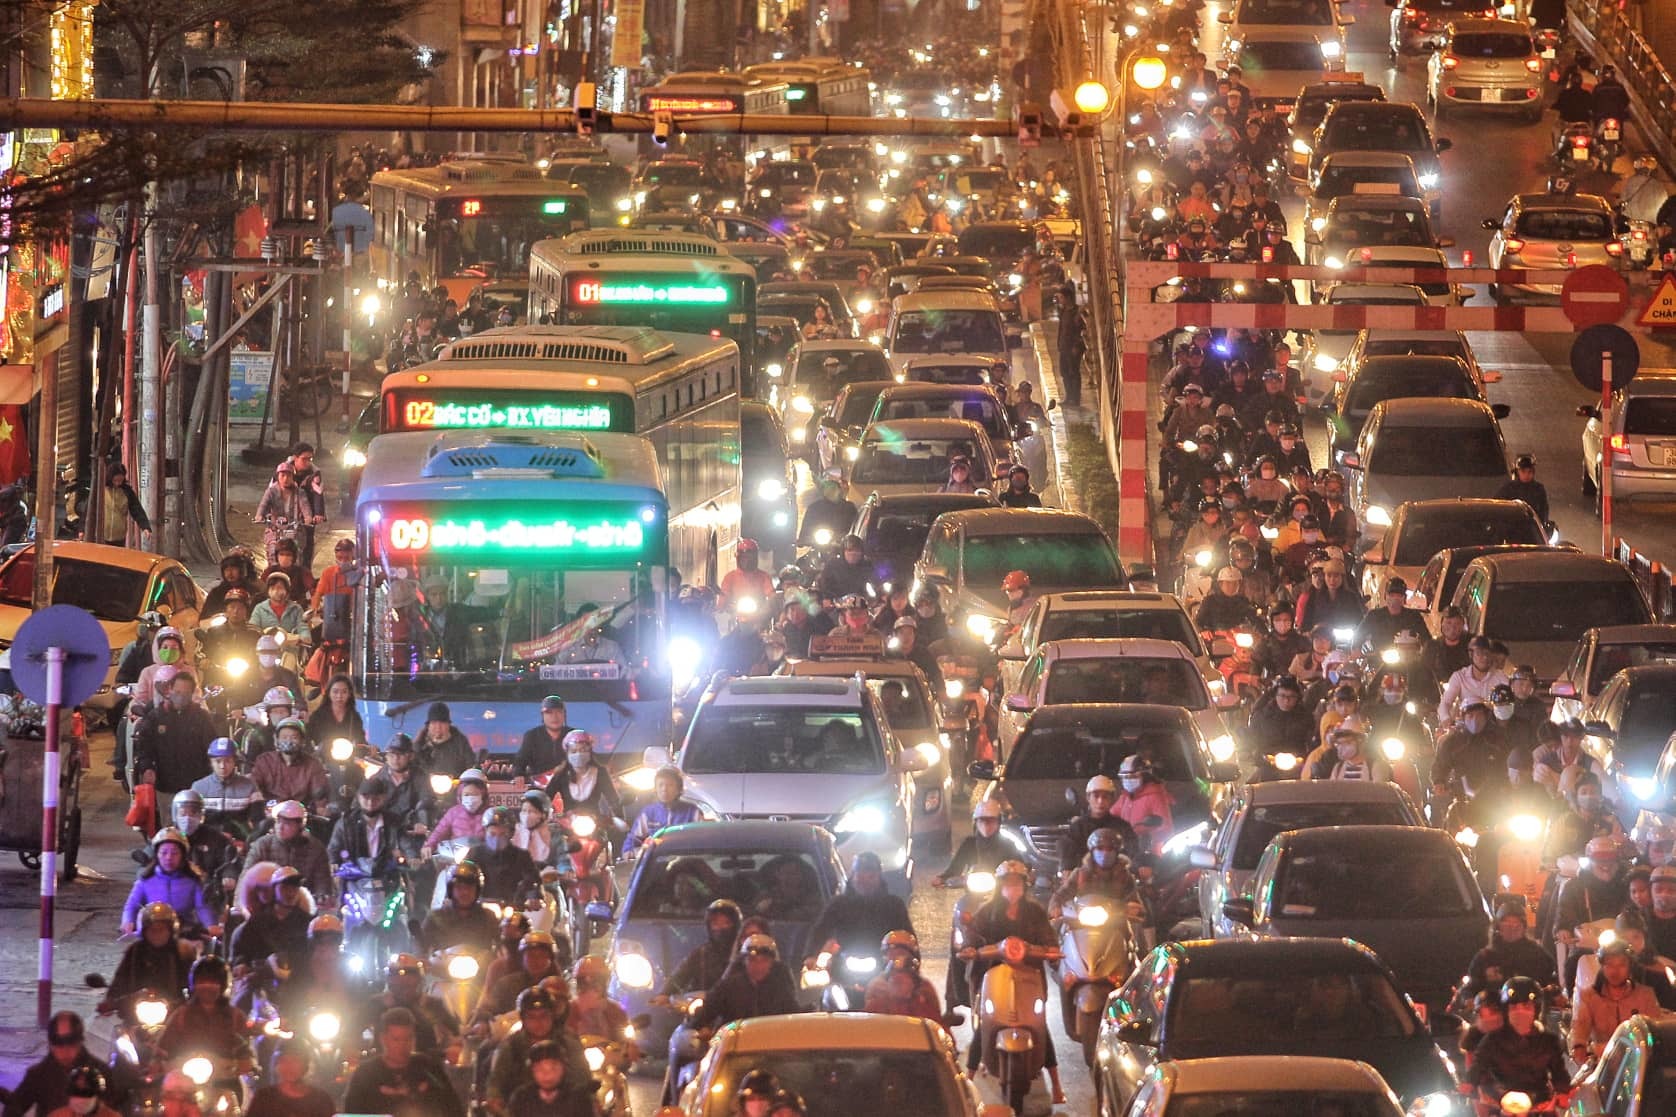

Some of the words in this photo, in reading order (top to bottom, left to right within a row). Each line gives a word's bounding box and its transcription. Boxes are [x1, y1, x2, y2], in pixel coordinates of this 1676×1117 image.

[580, 284, 599, 301] 01
[407, 402, 433, 424] 02
[391, 520, 428, 549] 09
